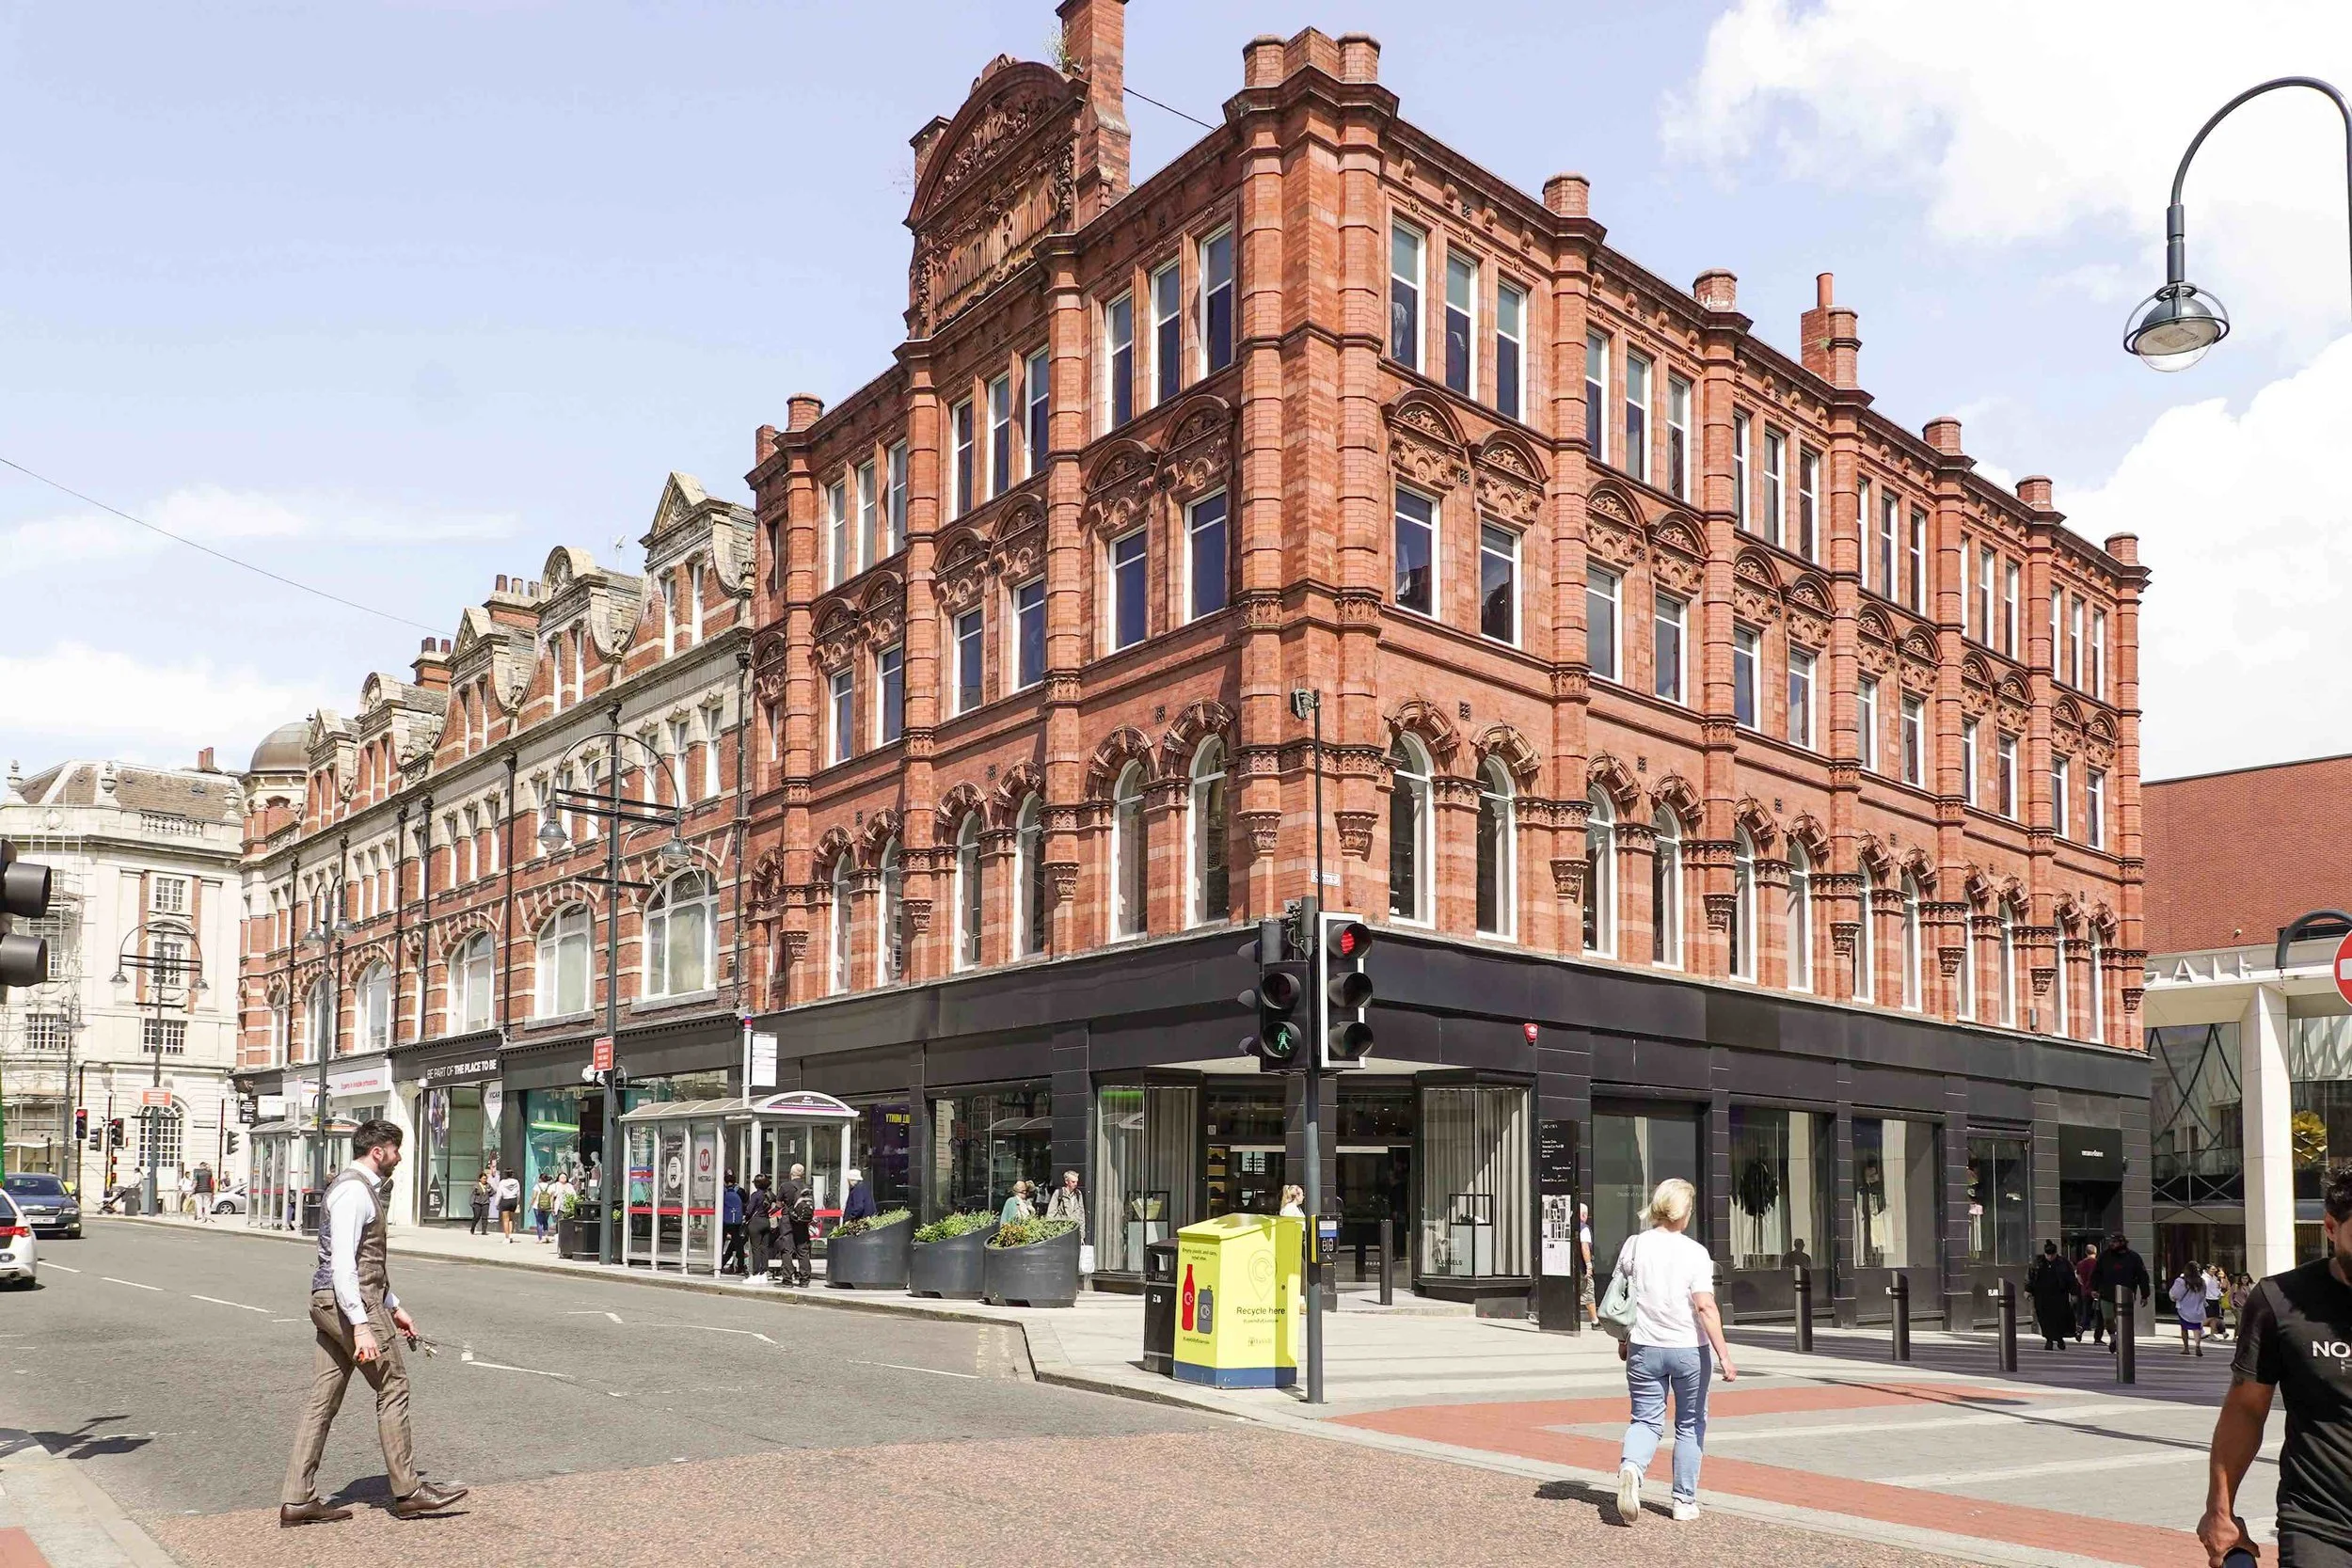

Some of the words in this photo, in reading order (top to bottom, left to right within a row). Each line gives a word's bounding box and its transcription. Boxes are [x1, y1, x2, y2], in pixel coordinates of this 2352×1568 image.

[427, 1069, 434, 1079] BE
[434, 1067, 446, 1078] PART
[447, 1065, 453, 1076] OF
[454, 1064, 464, 1074] THE
[465, 1062, 481, 1073] PLACE
[482, 1060, 488, 1070] TO
[489, 1059, 497, 1069] BE
[1236, 1307, 1267, 1316] Recycle
[1268, 1307, 1286, 1315] here
[2312, 1340, 2352, 1358] NO
